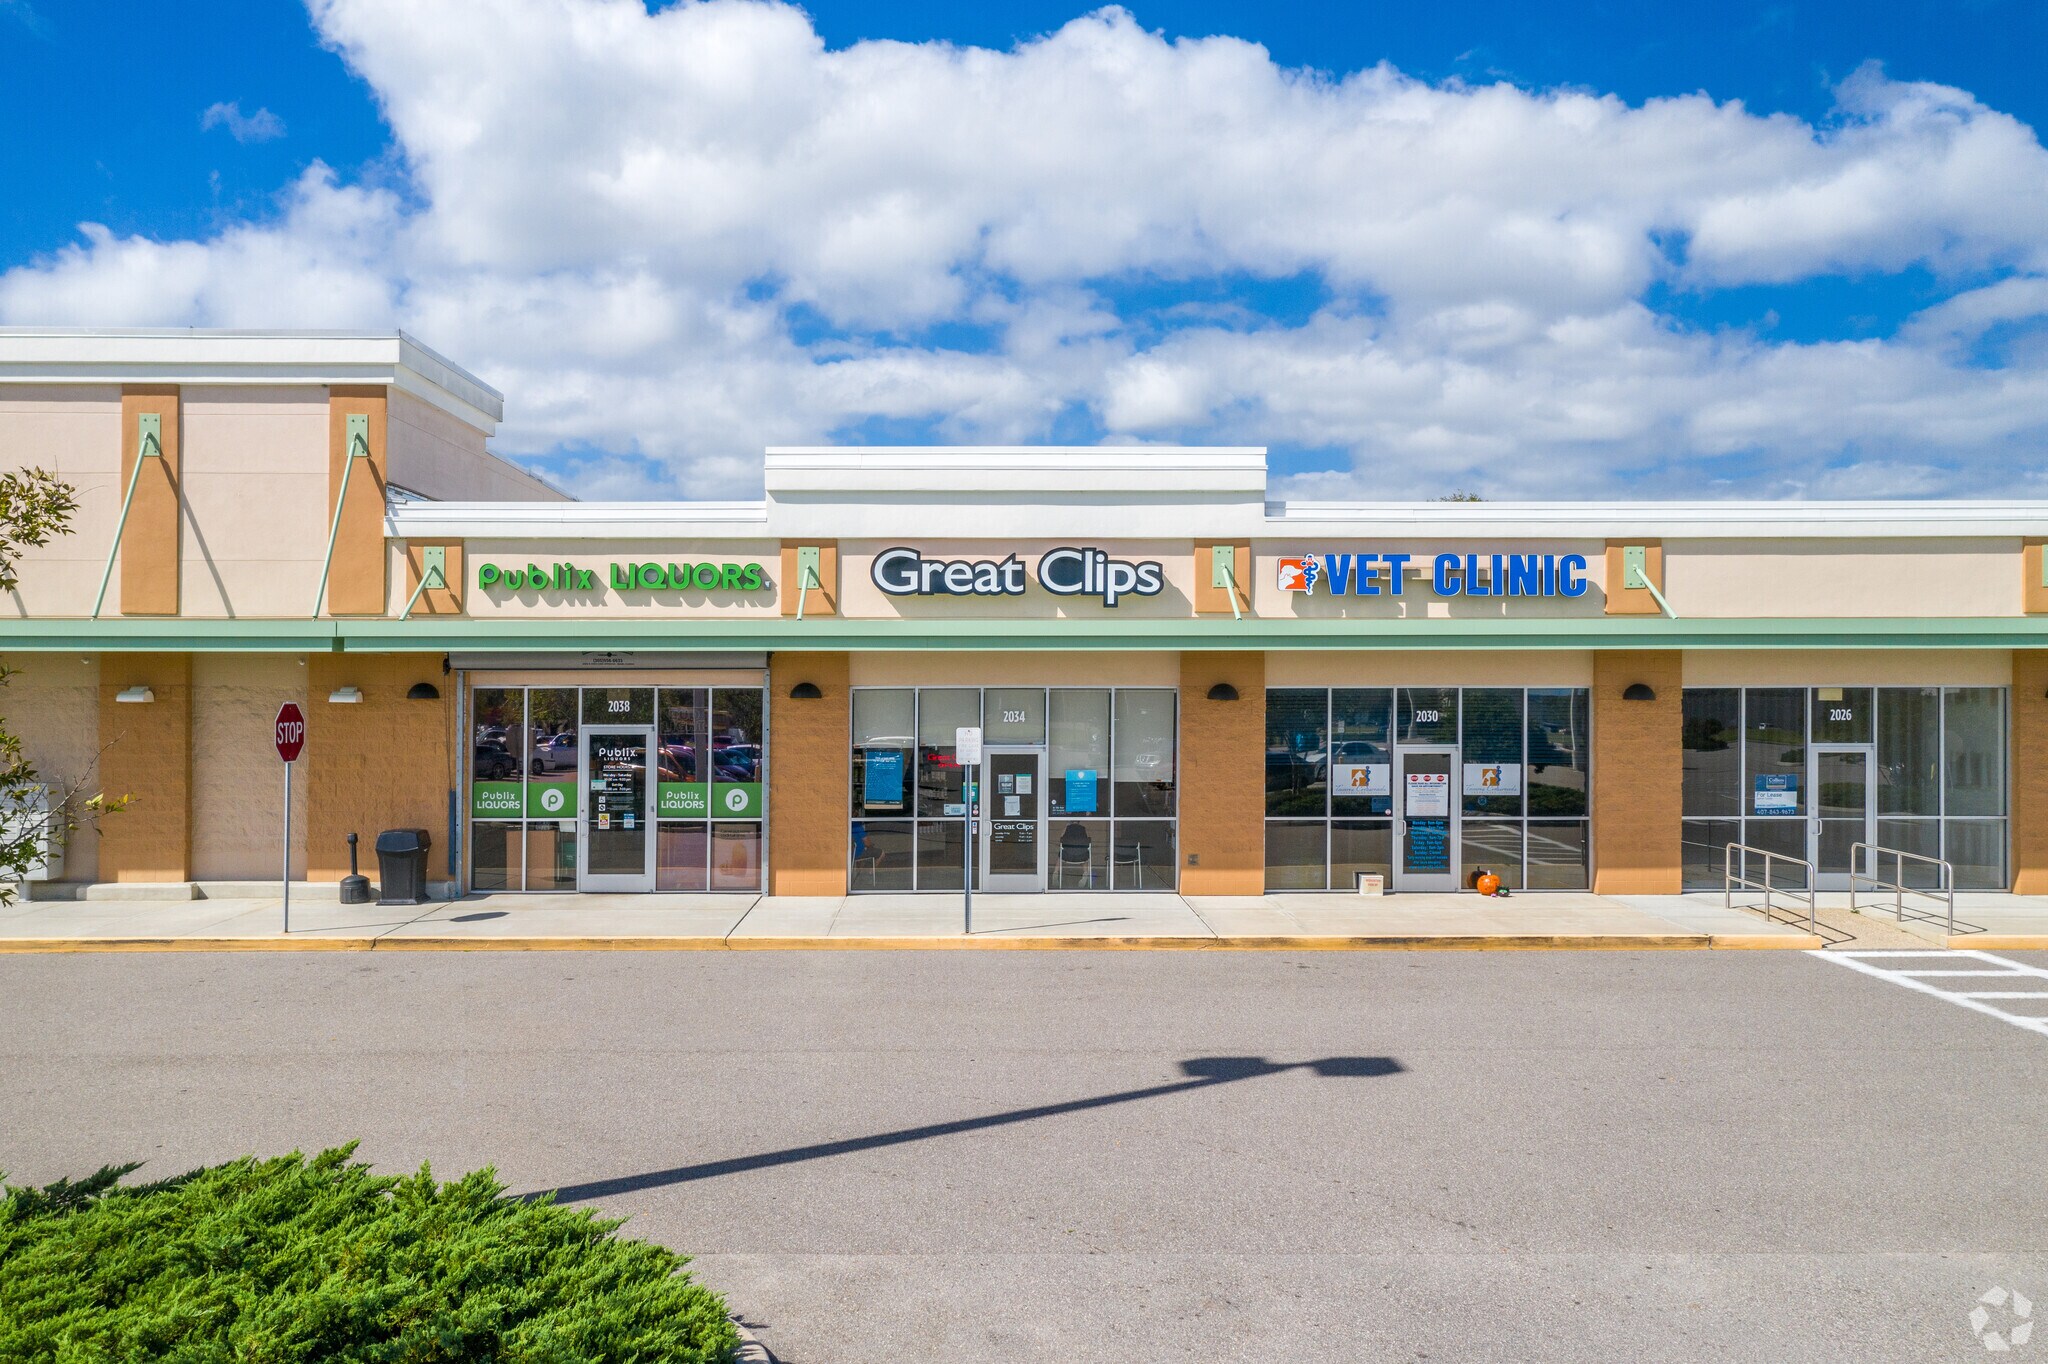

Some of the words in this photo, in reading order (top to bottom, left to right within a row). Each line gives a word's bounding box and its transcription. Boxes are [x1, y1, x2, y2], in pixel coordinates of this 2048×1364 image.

[478, 561, 594, 591] Publix
[610, 561, 763, 591] LIQUORS
[871, 547, 1026, 596] Great
[1037, 547, 1165, 608] Clips
[1323, 552, 1411, 596] VET
[1432, 552, 1588, 597] CLINIC
[608, 700, 631, 713] 2038
[1003, 710, 1026, 723] 2034
[1415, 710, 1439, 723] 2030
[1829, 708, 1852, 722] 2026
[277, 721, 303, 744] STOP
[598, 747, 636, 757] Publix
[482, 791, 515, 800] Publix
[666, 791, 700, 800] Publix
[476, 800, 520, 809] LIQUORS
[660, 800, 705, 809] LIQUORS
[993, 822, 1015, 830] Great
[1016, 822, 1034, 831] Clips
